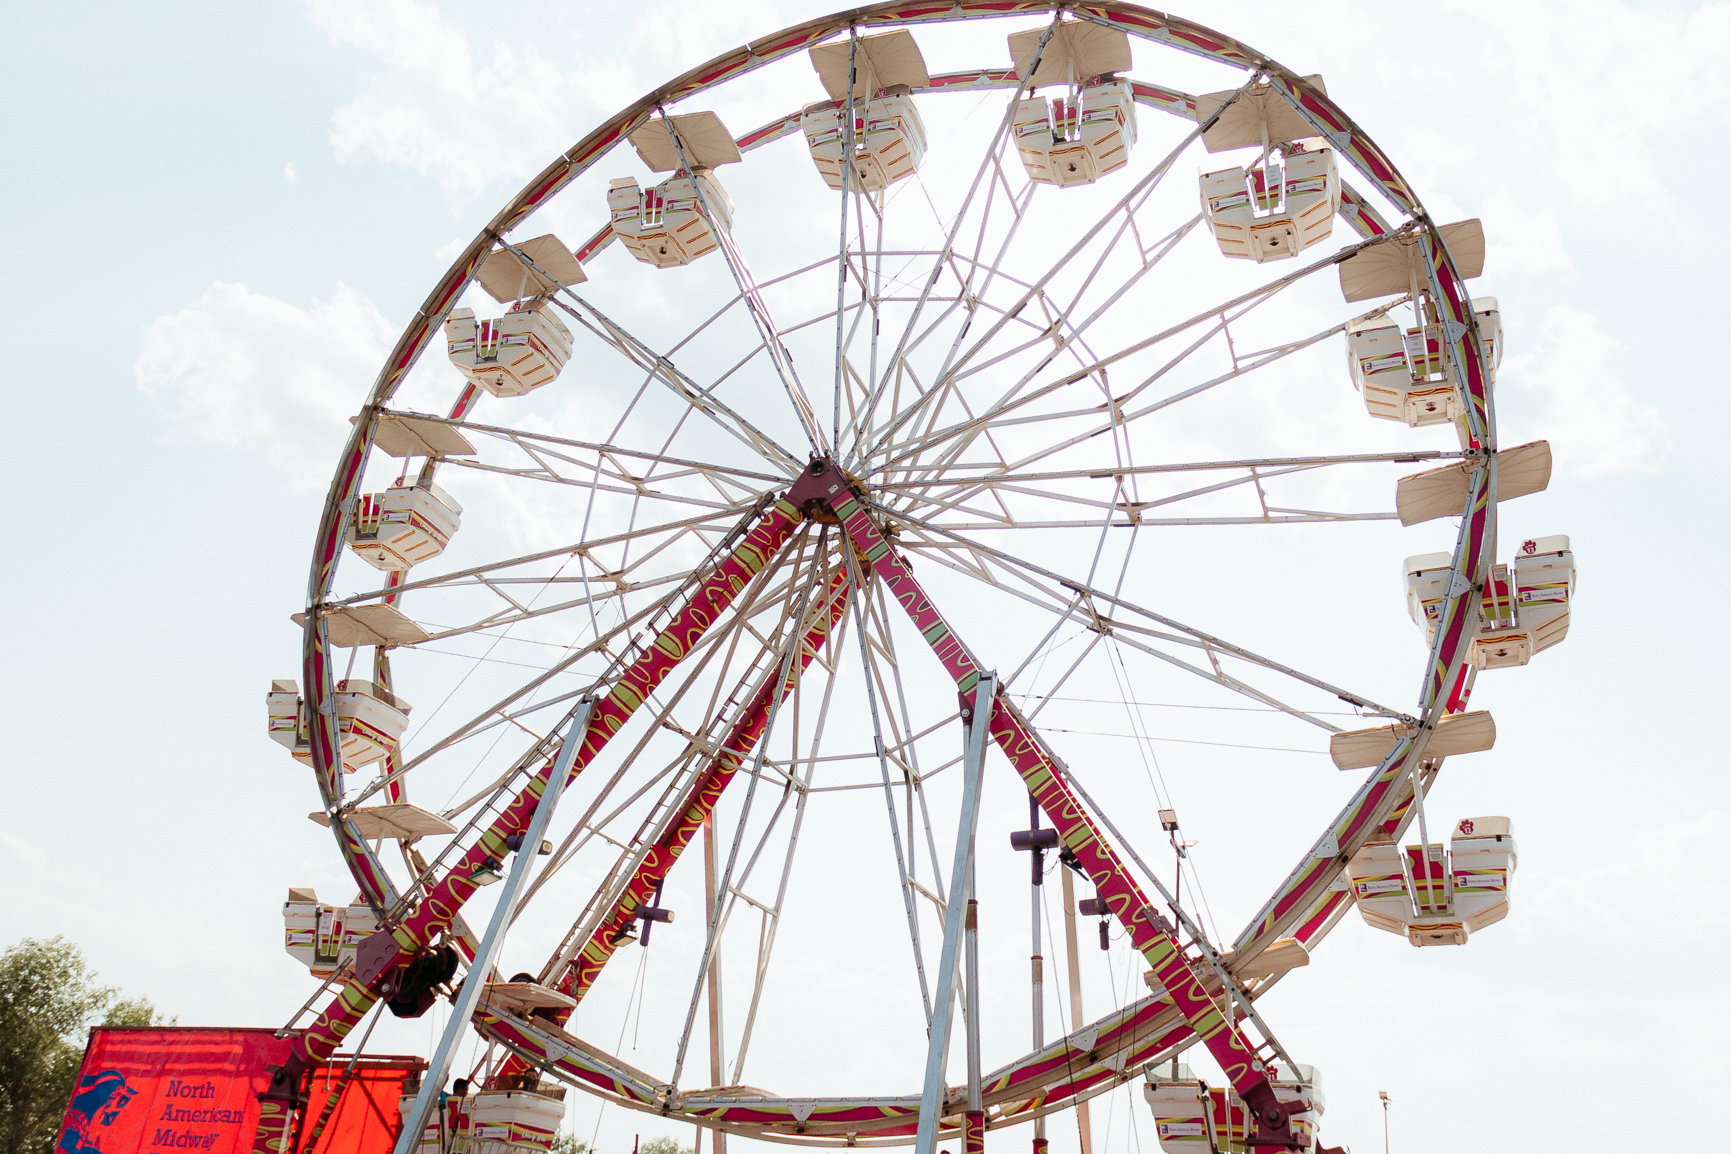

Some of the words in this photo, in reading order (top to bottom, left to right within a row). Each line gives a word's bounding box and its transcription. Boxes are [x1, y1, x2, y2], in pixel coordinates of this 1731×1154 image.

[165, 1080, 216, 1099] North
[159, 1104, 243, 1124] American
[151, 1129, 220, 1151] Midway
